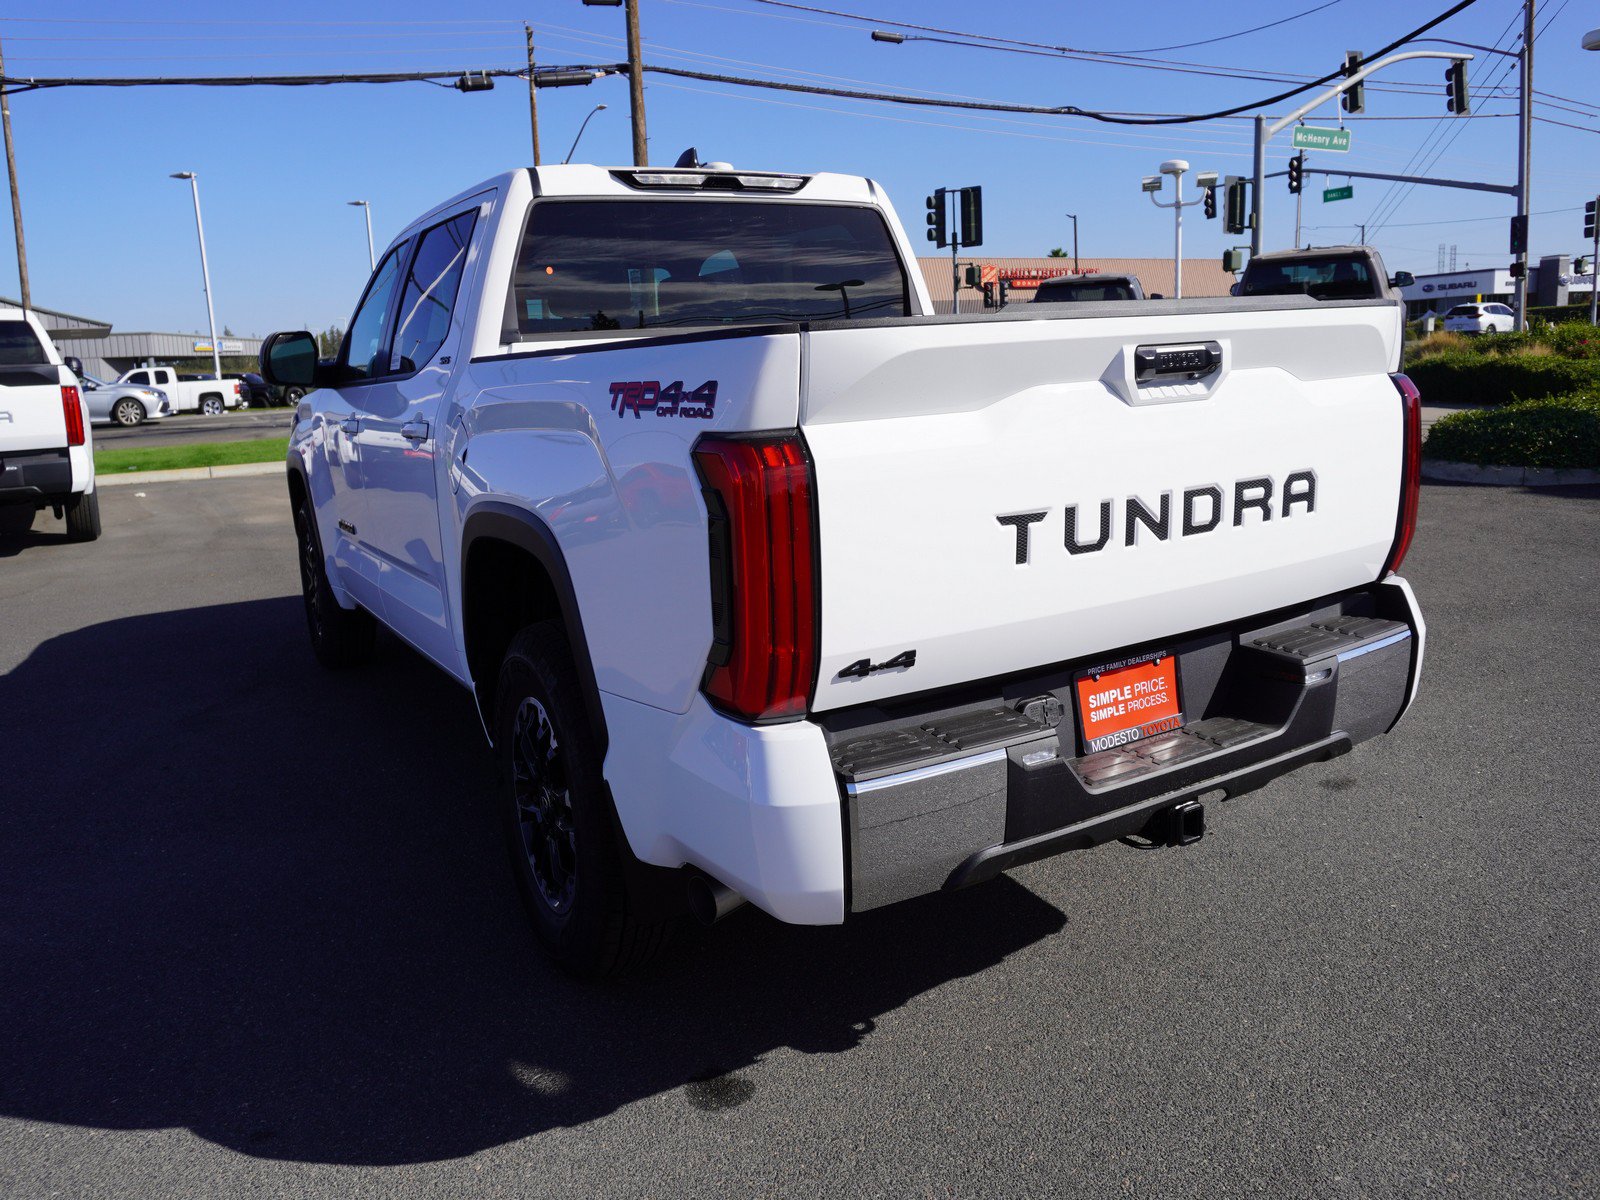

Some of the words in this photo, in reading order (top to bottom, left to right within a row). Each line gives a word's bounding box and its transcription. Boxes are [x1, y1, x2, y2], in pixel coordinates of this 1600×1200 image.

[1296, 132, 1330, 146] McHenry
[1332, 135, 1348, 146] Ave
[998, 267, 1033, 278] FAMILY
[1035, 267, 1069, 278] THRIFT
[1438, 281, 1477, 291] SUBARU
[609, 381, 661, 419] TRD
[656, 406, 678, 418] OFF
[679, 407, 714, 419] ROAD
[995, 469, 1317, 565] TUNDRA
[1088, 666, 1105, 675] PRICE
[1106, 660, 1127, 670] FAMILY
[1128, 650, 1166, 664] DEALERSHIPS
[1089, 686, 1132, 708] SIMPLE
[1134, 677, 1168, 696] PRICE.
[1090, 704, 1125, 722] SIMPLE
[1128, 692, 1169, 712] PROCESS.
[1092, 729, 1139, 752] MODESTO
[1142, 717, 1180, 736] TOYOTA
